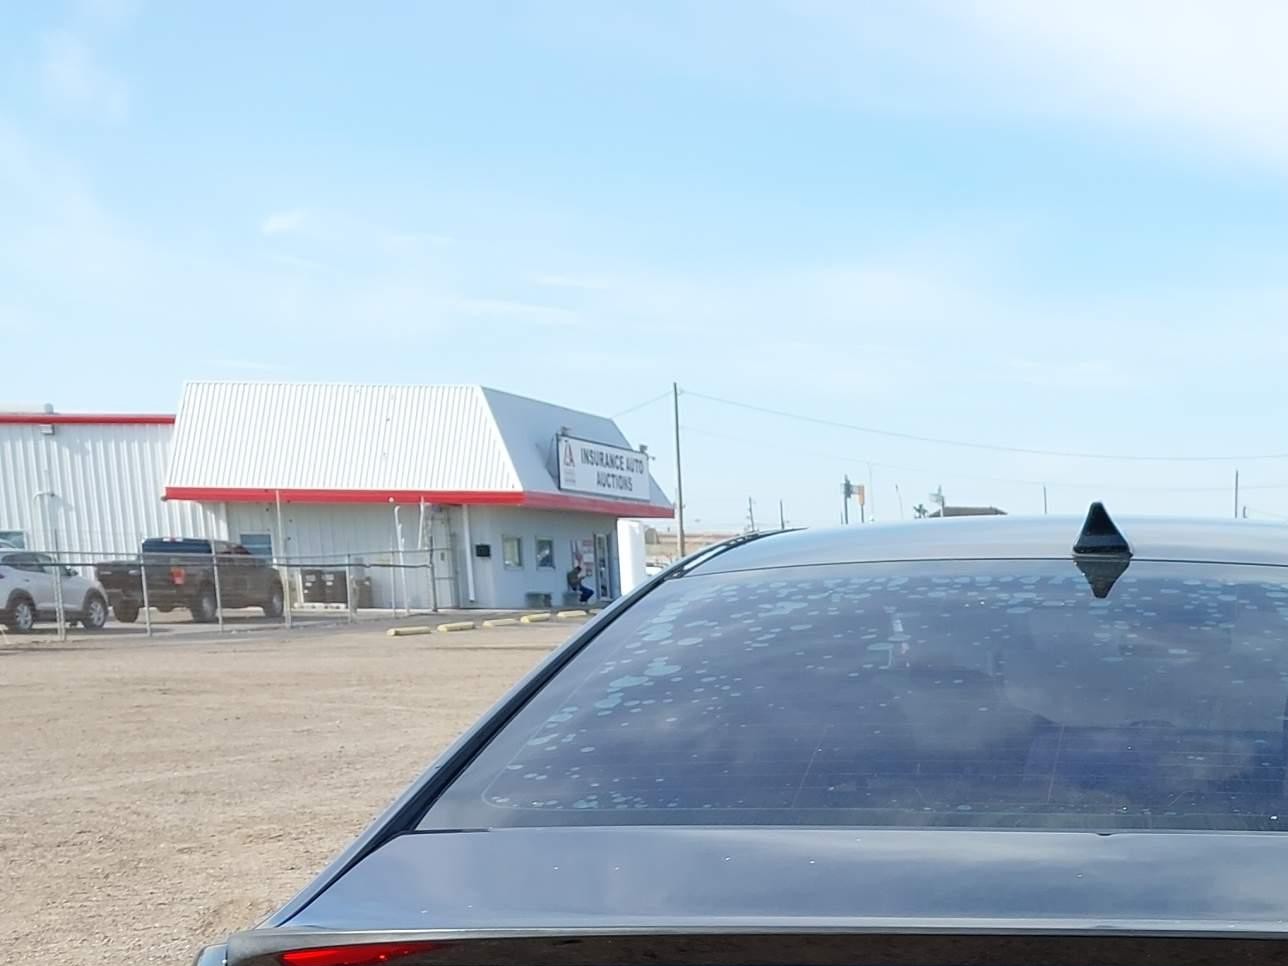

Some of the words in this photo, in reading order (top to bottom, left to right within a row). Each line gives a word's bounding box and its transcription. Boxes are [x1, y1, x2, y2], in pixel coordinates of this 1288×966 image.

[580, 447, 625, 472] INSURANCE
[626, 457, 645, 475] AUTO
[596, 471, 633, 492] AUCTIONS
